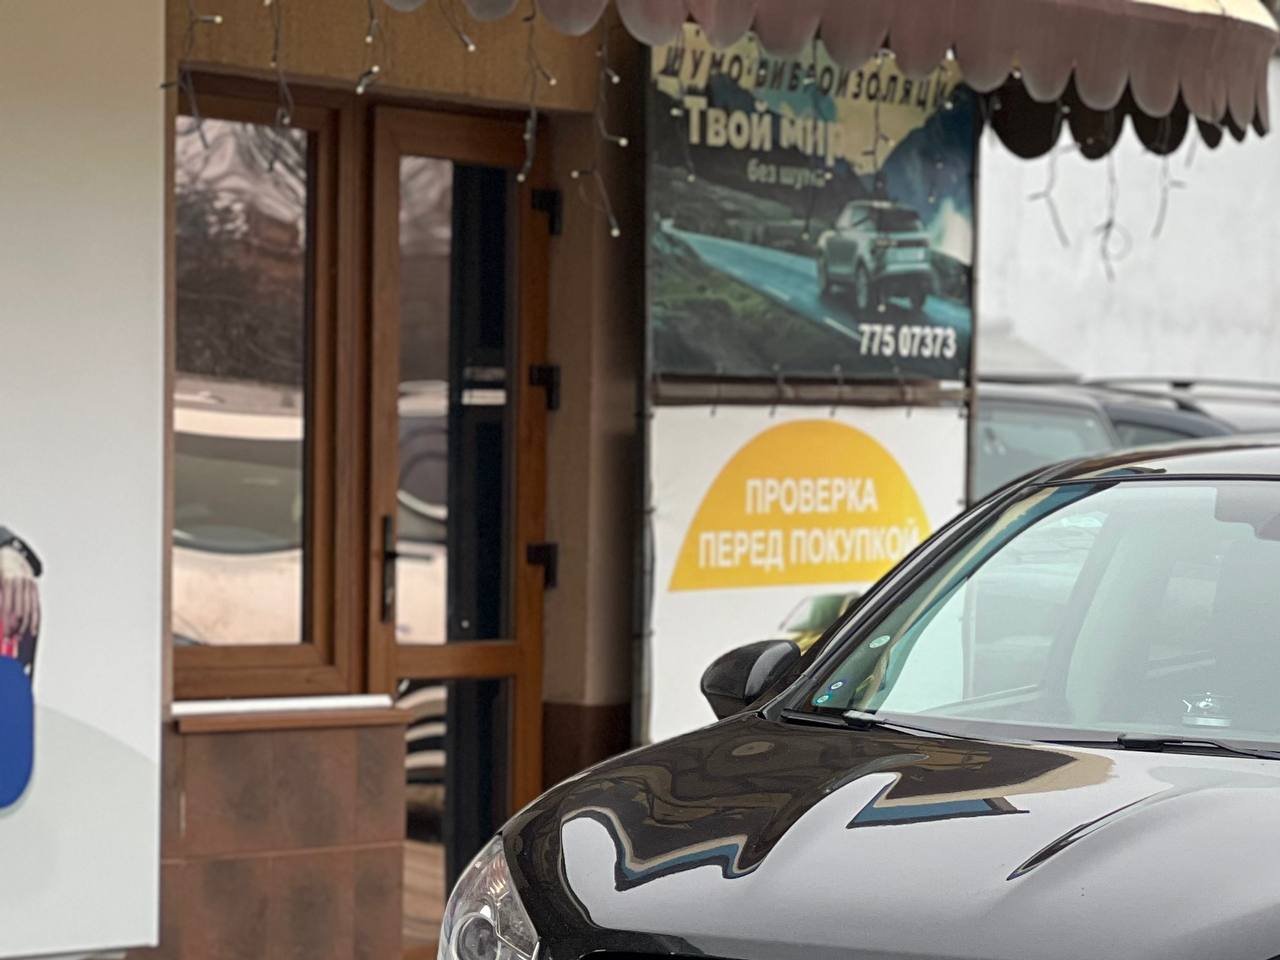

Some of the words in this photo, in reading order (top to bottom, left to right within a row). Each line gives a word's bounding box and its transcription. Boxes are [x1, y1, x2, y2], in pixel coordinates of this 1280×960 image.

[684, 95, 772, 151] Твой
[747, 158, 777, 184] без
[858, 323, 896, 357] 775
[898, 325, 957, 359] 07373
[746, 477, 878, 515] ПРОВЕРКА
[698, 529, 785, 572] ПЕРЕД
[790, 518, 919, 564] ПОКУПКОЙ
